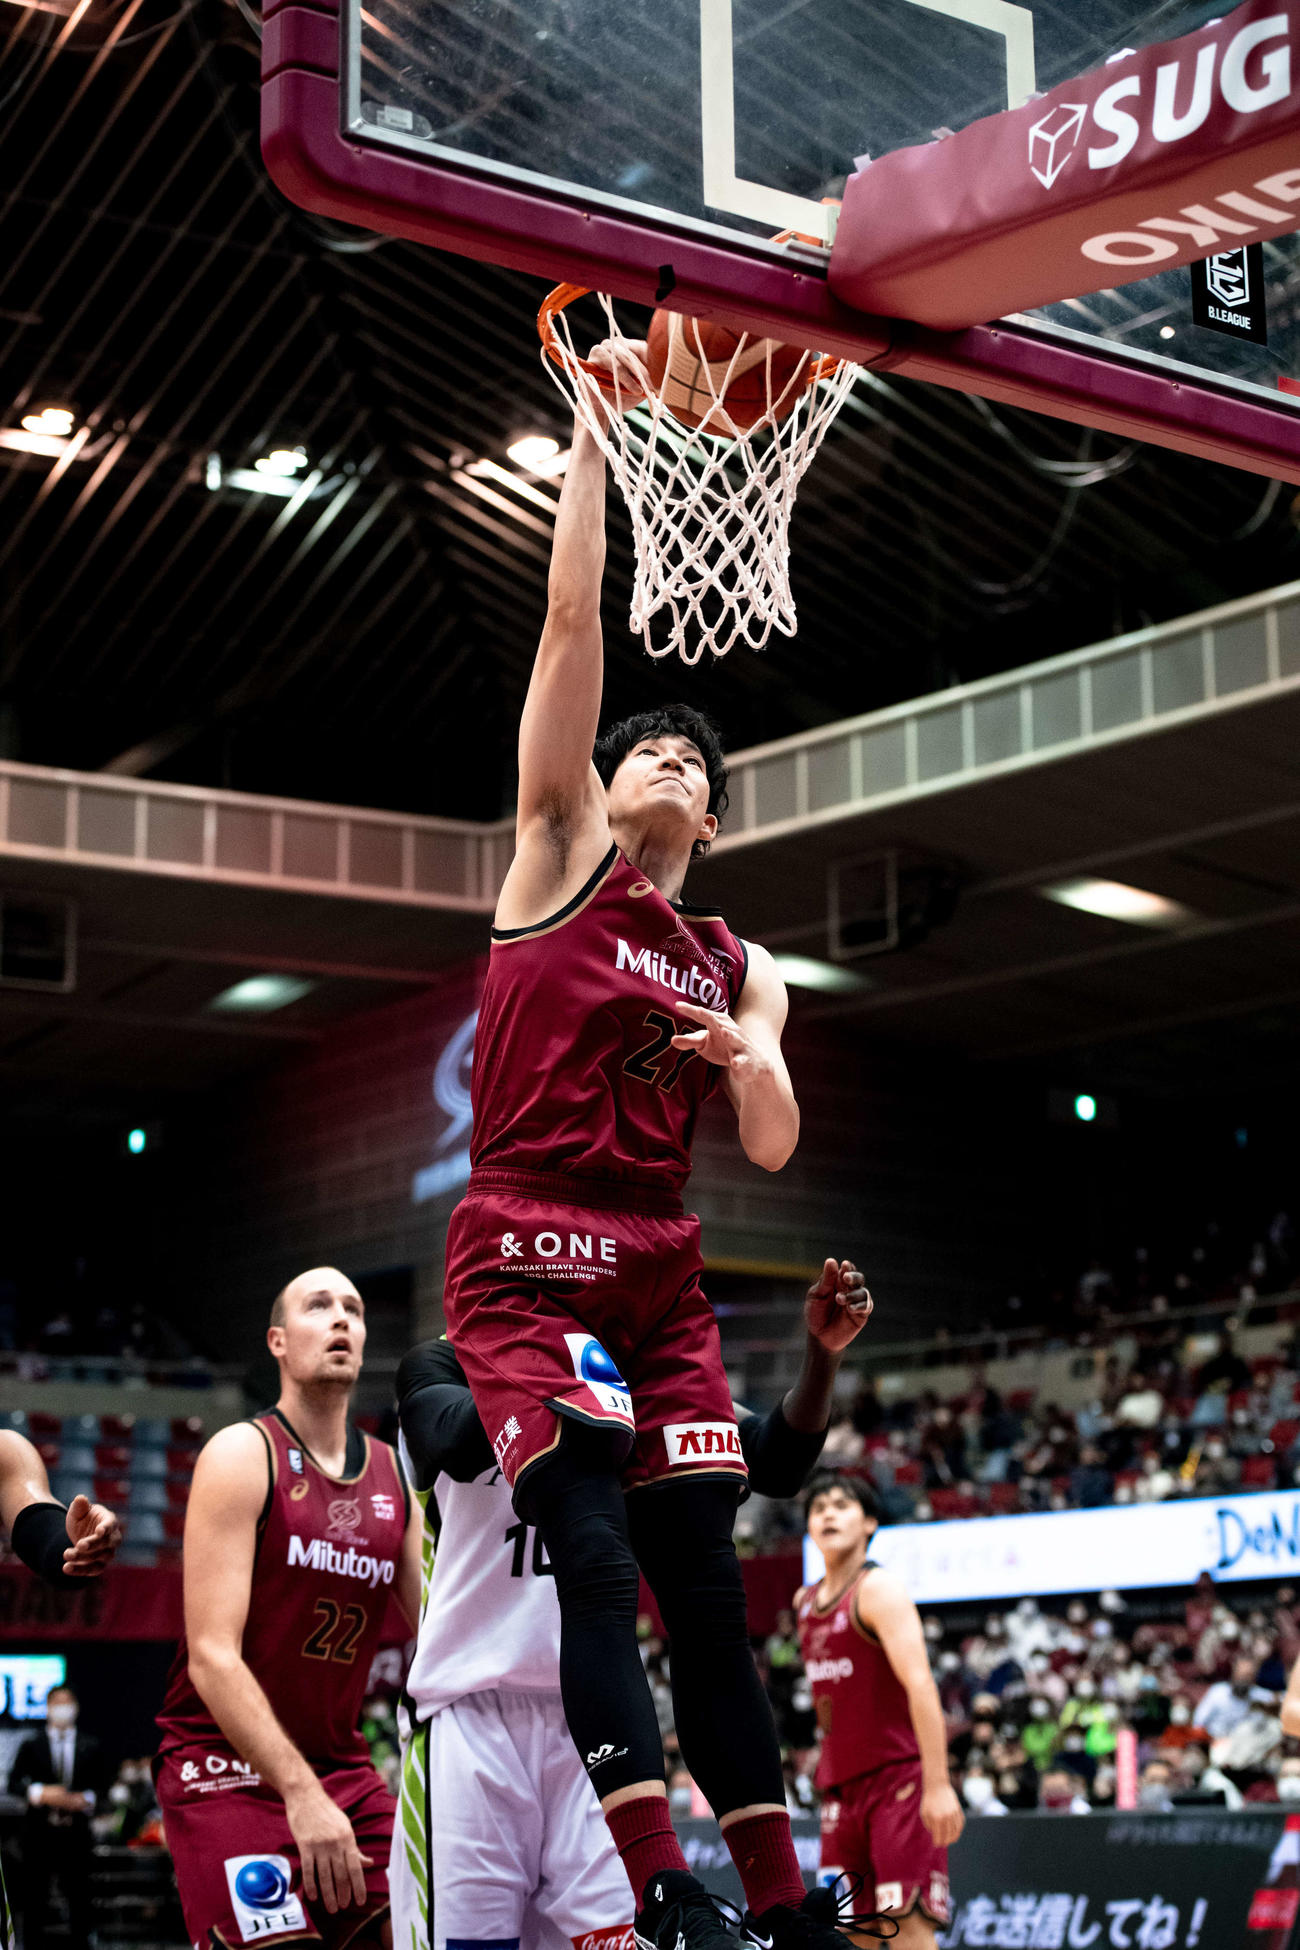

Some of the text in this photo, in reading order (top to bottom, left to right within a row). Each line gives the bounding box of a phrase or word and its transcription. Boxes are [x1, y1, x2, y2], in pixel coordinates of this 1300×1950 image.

[1088, 14, 1291, 170] SUG
[1208, 305, 1252, 330] B.LEAGUE
[616, 938, 729, 1014] Mitutoy
[535, 1231, 617, 1263] ONE
[499, 1263, 617, 1277] KAWASAKI BRAVE THUNDERS
[547, 1272, 596, 1281] CHALLENGE
[287, 1535, 395, 1588] Mitutoyo
[301, 1598, 368, 1664] 22
[247, 1911, 299, 1936] JFE
